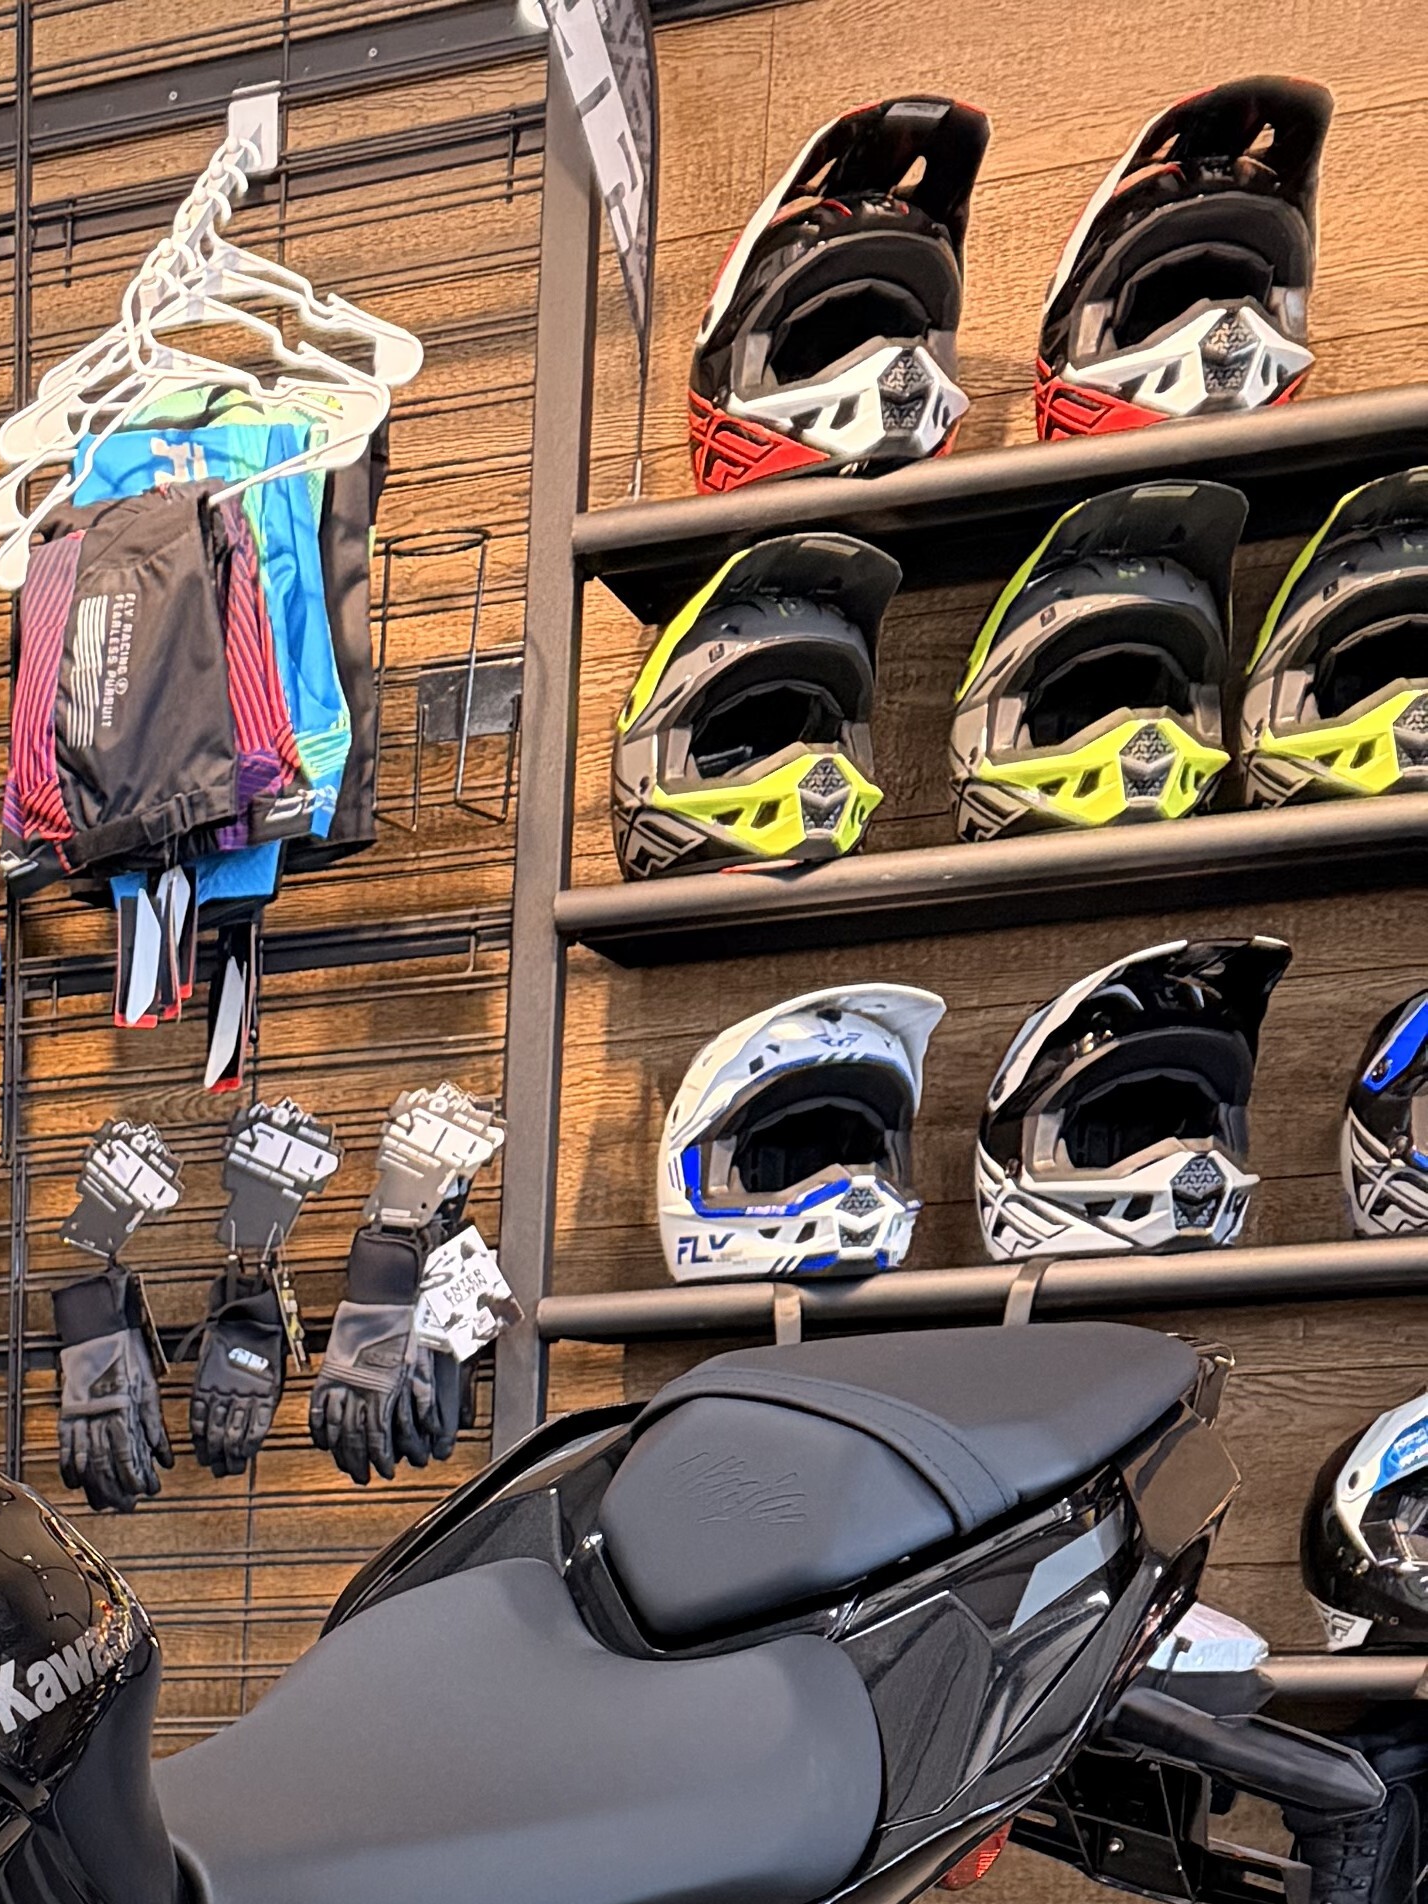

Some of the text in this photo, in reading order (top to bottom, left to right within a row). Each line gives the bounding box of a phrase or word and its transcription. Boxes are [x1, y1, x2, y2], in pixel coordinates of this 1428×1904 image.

[118, 593, 136, 675] FLY RACING
[101, 594, 125, 728] FEARLESS PURSUIT
[677, 1232, 736, 1265] FLY
[443, 1268, 483, 1299] ENTER
[448, 1278, 488, 1306] TO WIN
